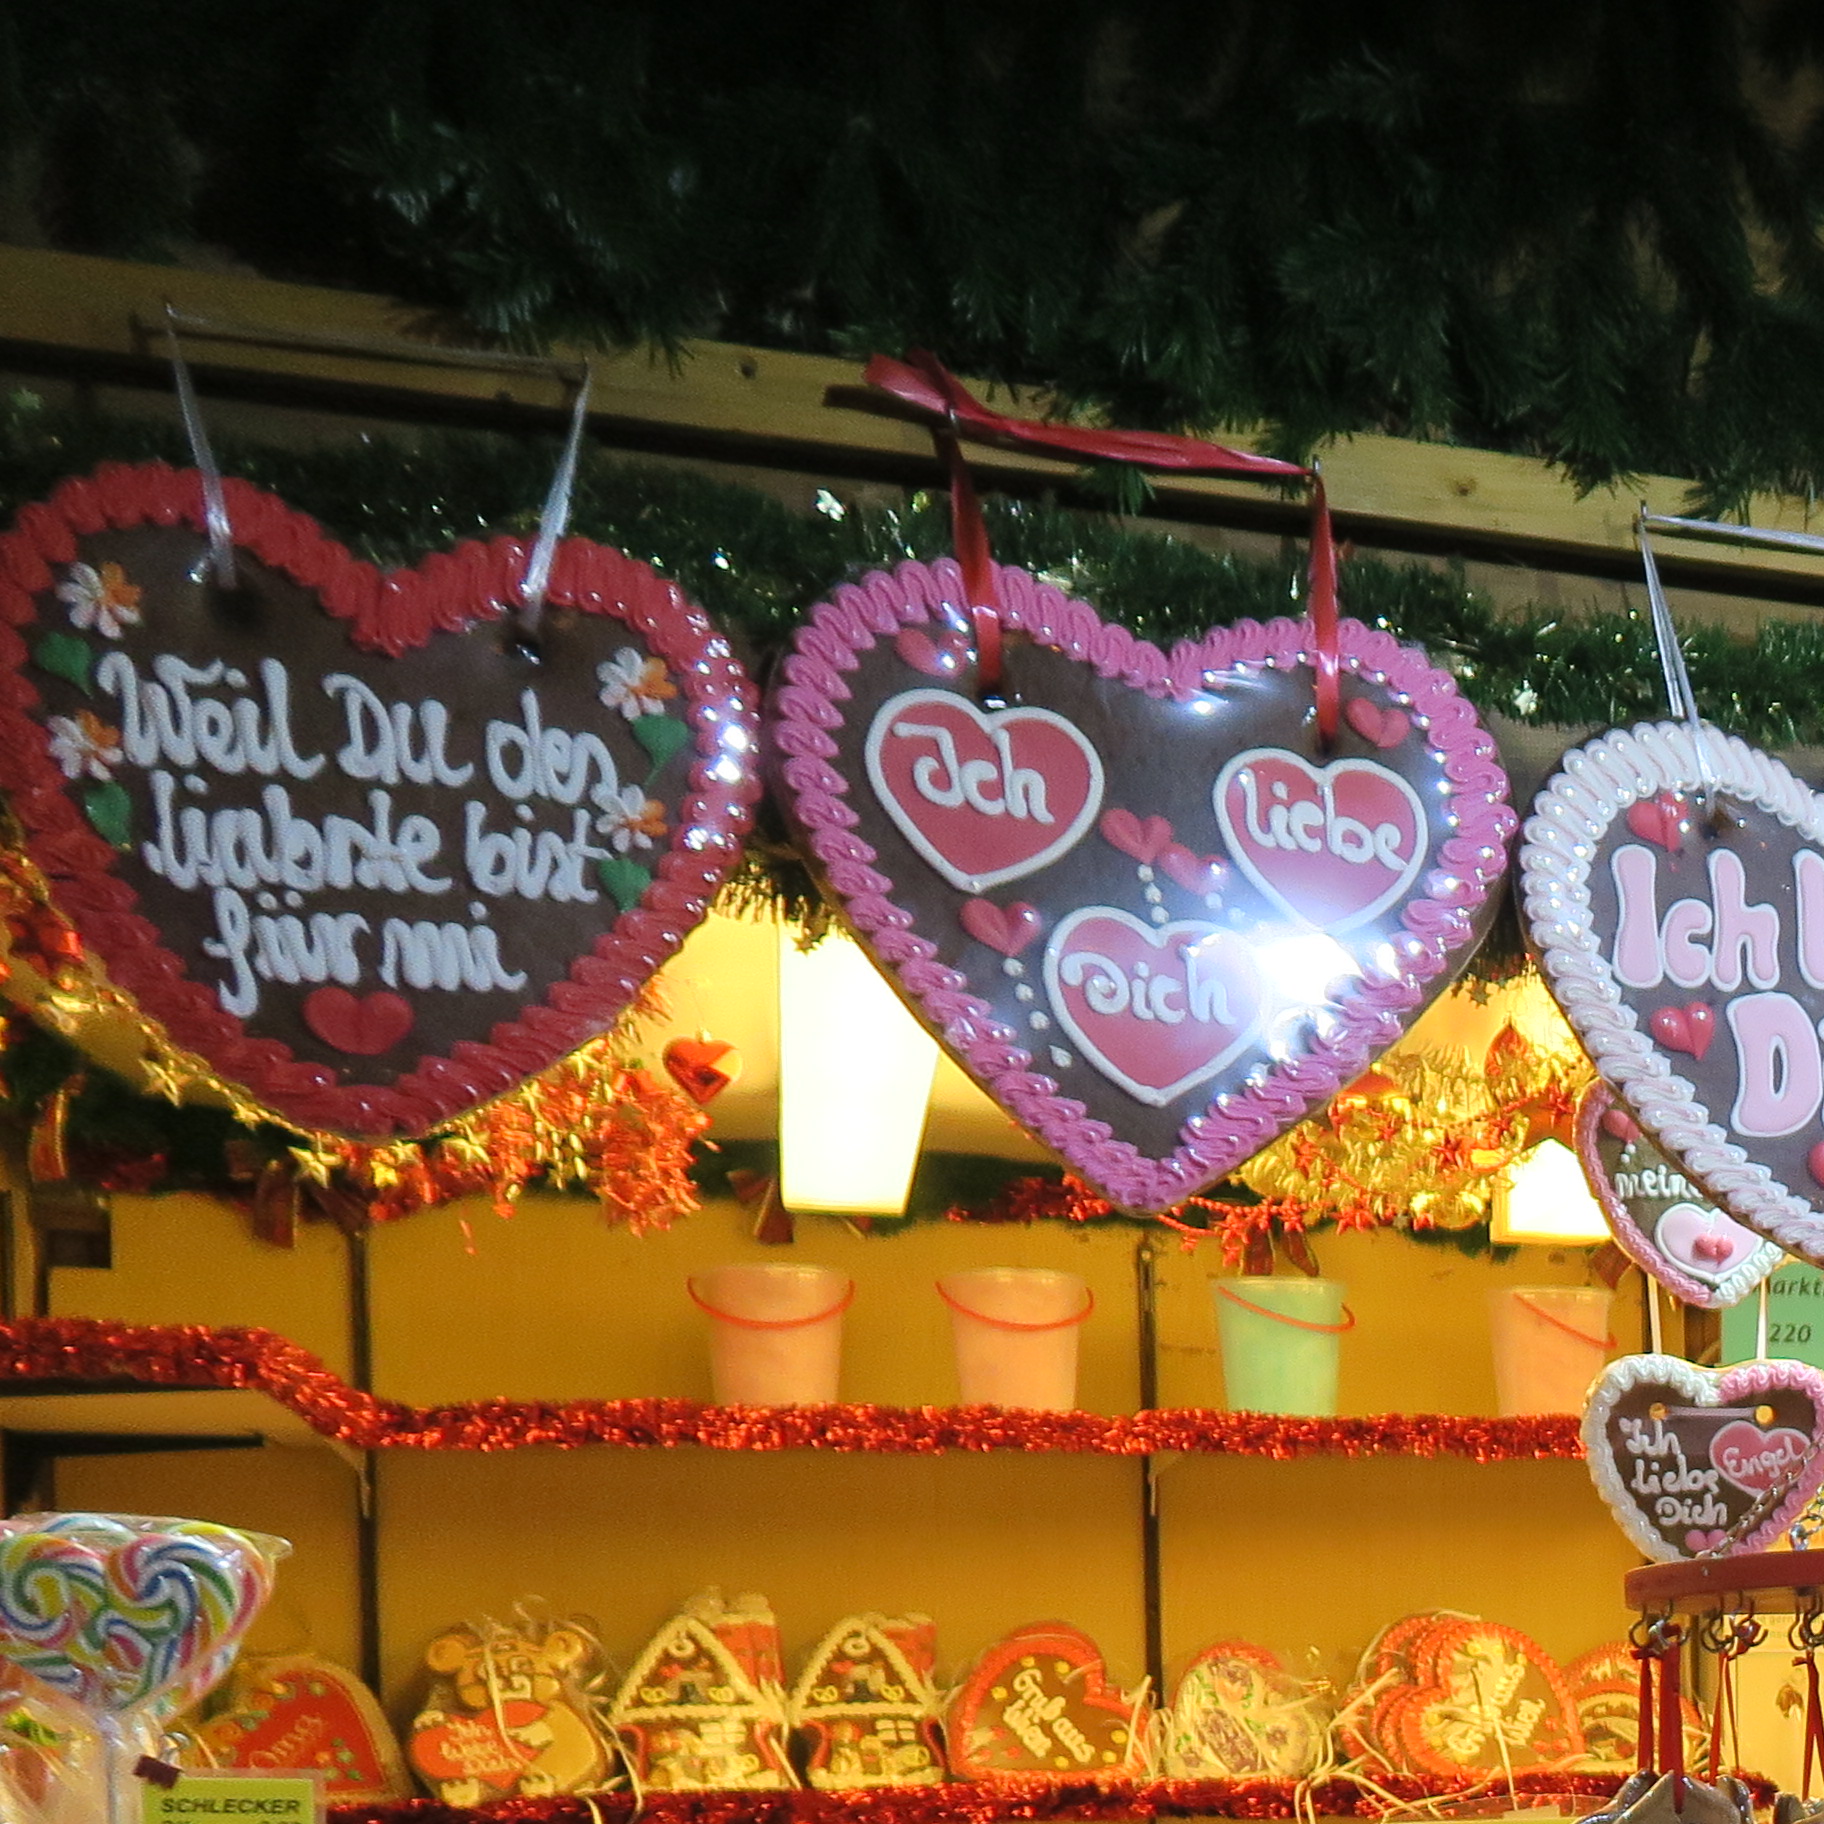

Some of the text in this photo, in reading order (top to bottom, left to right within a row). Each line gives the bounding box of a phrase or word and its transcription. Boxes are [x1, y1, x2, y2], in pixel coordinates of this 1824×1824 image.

[97, 648, 473, 788] Weil Du
[893, 720, 1055, 826] Ich
[1240, 770, 1410, 873] liebe
[381, 902, 526, 992] mi
[1611, 845, 1782, 992] Ich
[1722, 1436, 1800, 1478] Engel
[1655, 1493, 1728, 1526] Dich
[161, 1799, 300, 1814] SCHLECKER
